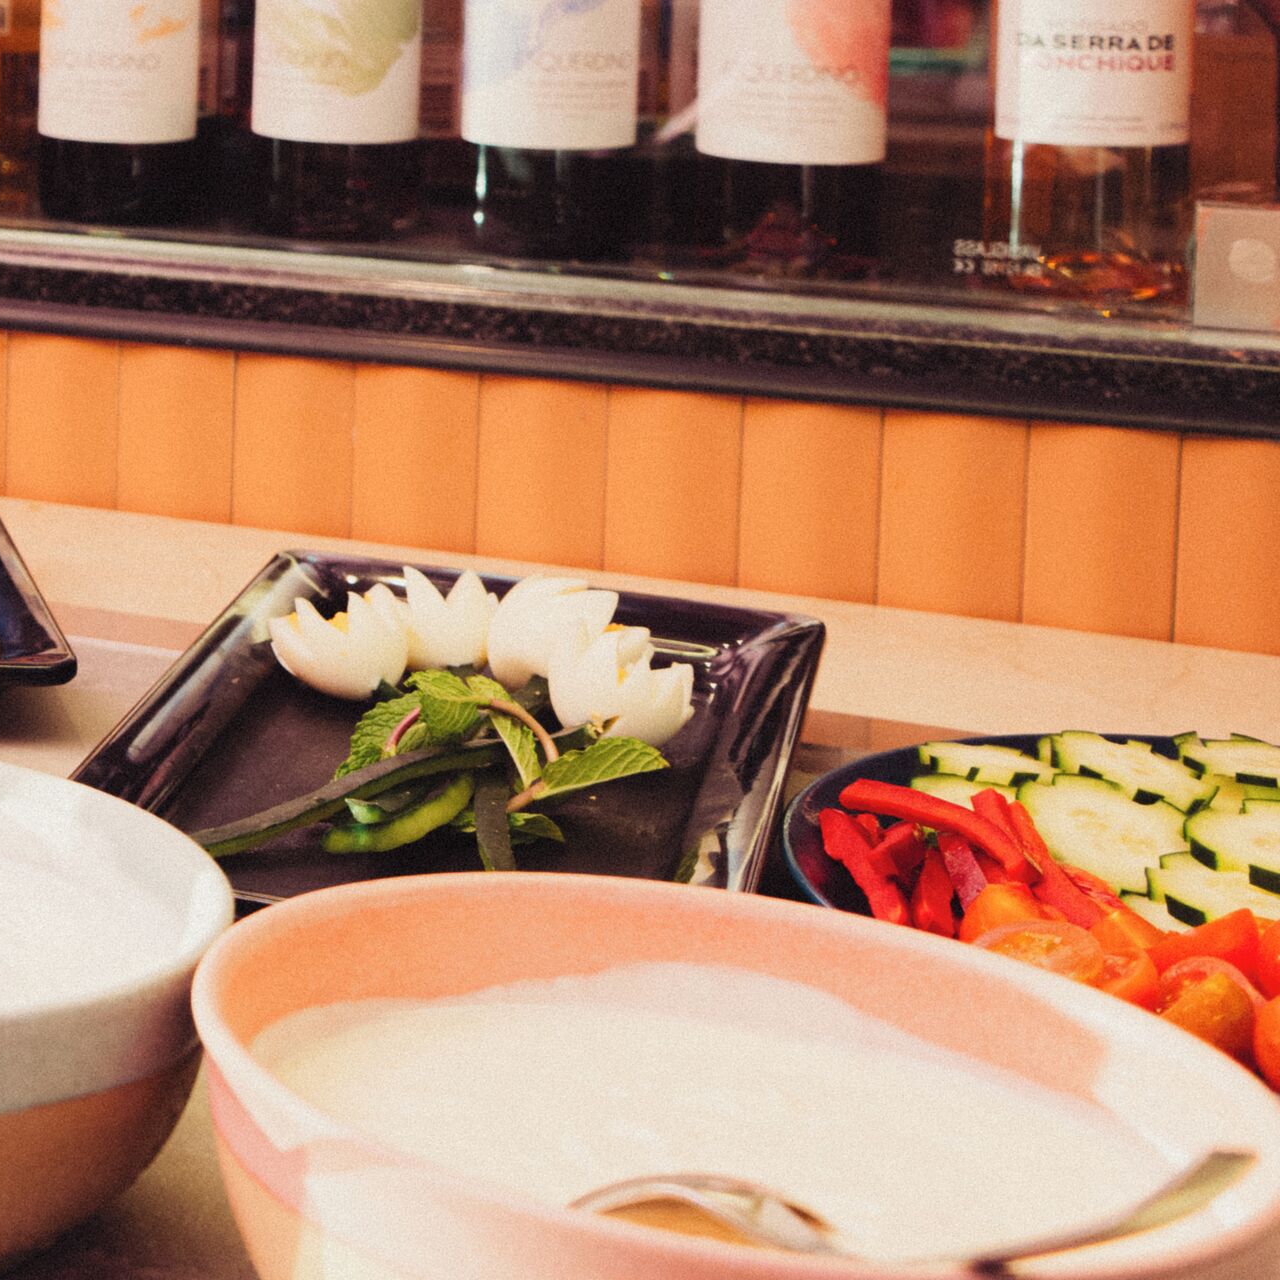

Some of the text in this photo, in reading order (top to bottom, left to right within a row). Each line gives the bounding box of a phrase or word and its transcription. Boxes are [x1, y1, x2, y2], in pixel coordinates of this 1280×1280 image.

[1052, 32, 1141, 51] SERRA
[1147, 33, 1176, 52] DE
[1032, 53, 1176, 73] ONCHIQUE
